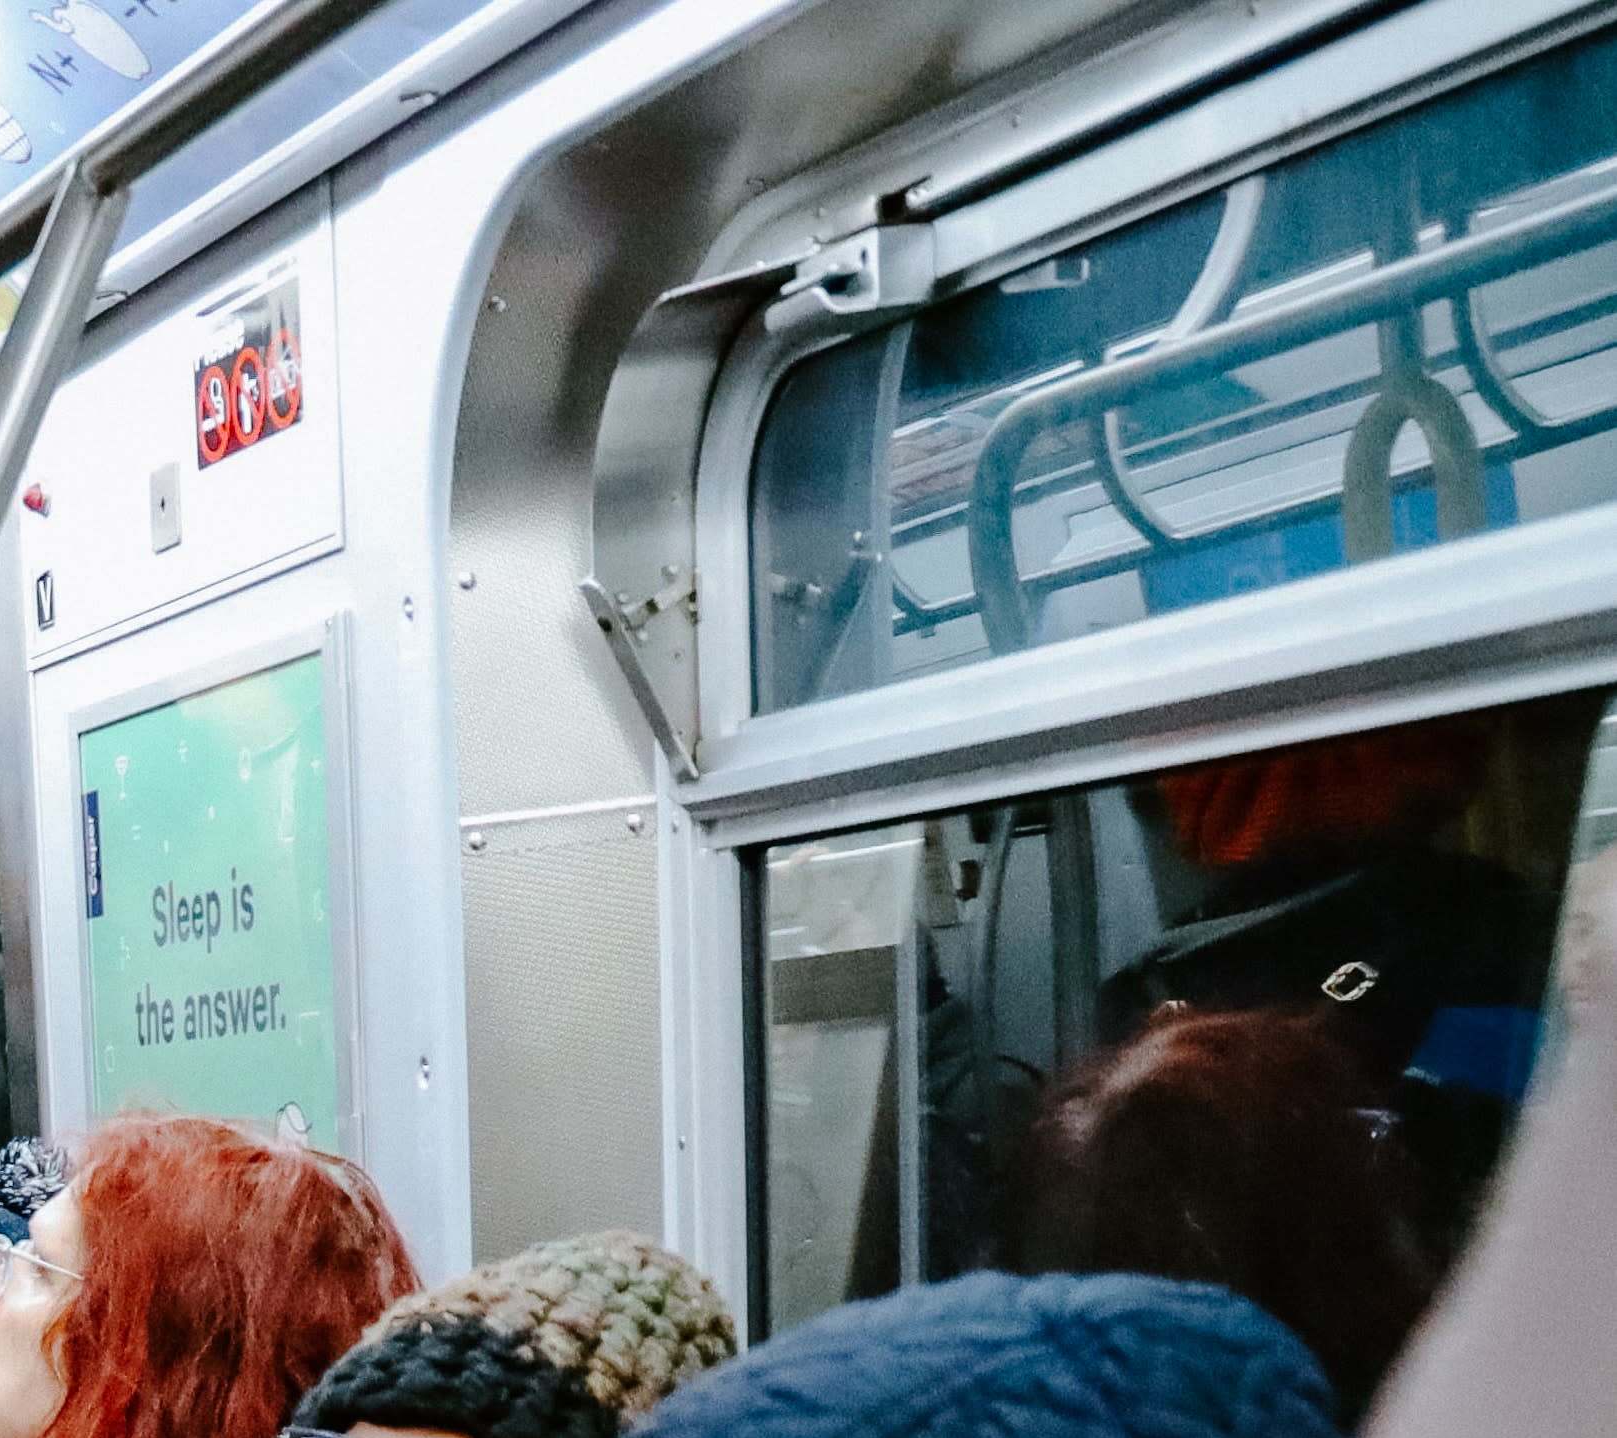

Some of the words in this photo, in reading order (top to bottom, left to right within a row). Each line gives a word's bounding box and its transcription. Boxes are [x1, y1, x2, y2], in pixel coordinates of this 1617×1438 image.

[152, 880, 222, 953] Sleep
[231, 867, 255, 933] is
[135, 982, 174, 1046] the
[184, 983, 286, 1041] answer.
